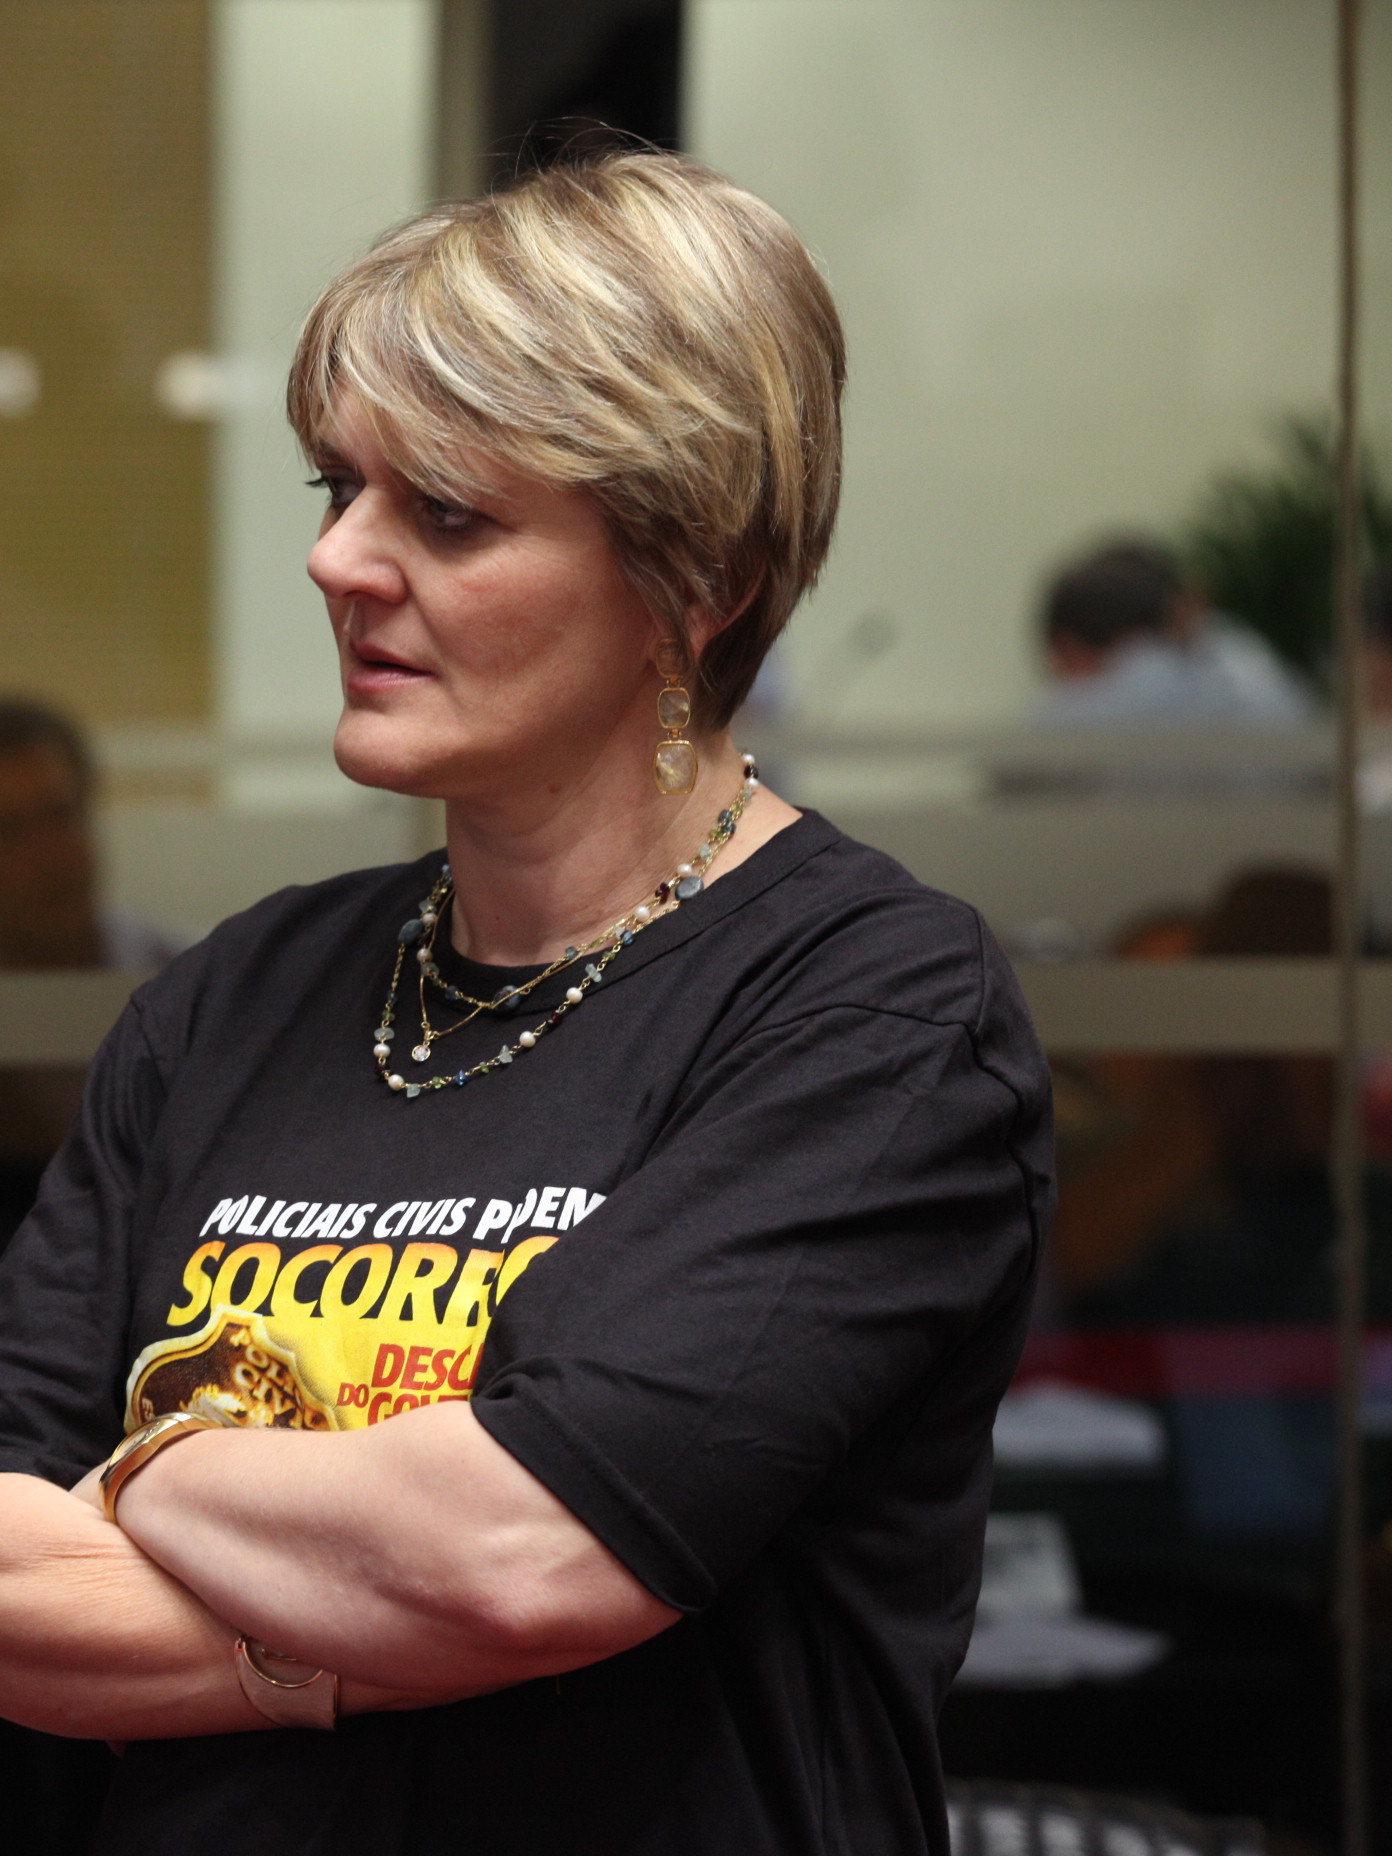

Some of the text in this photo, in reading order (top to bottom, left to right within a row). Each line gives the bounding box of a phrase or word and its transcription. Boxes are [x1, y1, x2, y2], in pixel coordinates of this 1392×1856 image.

[198, 1194, 377, 1239] POLICIAIS
[372, 1197, 476, 1238] CIVIS
[370, 1342, 485, 1391] DESC
[336, 1382, 370, 1408] DO
